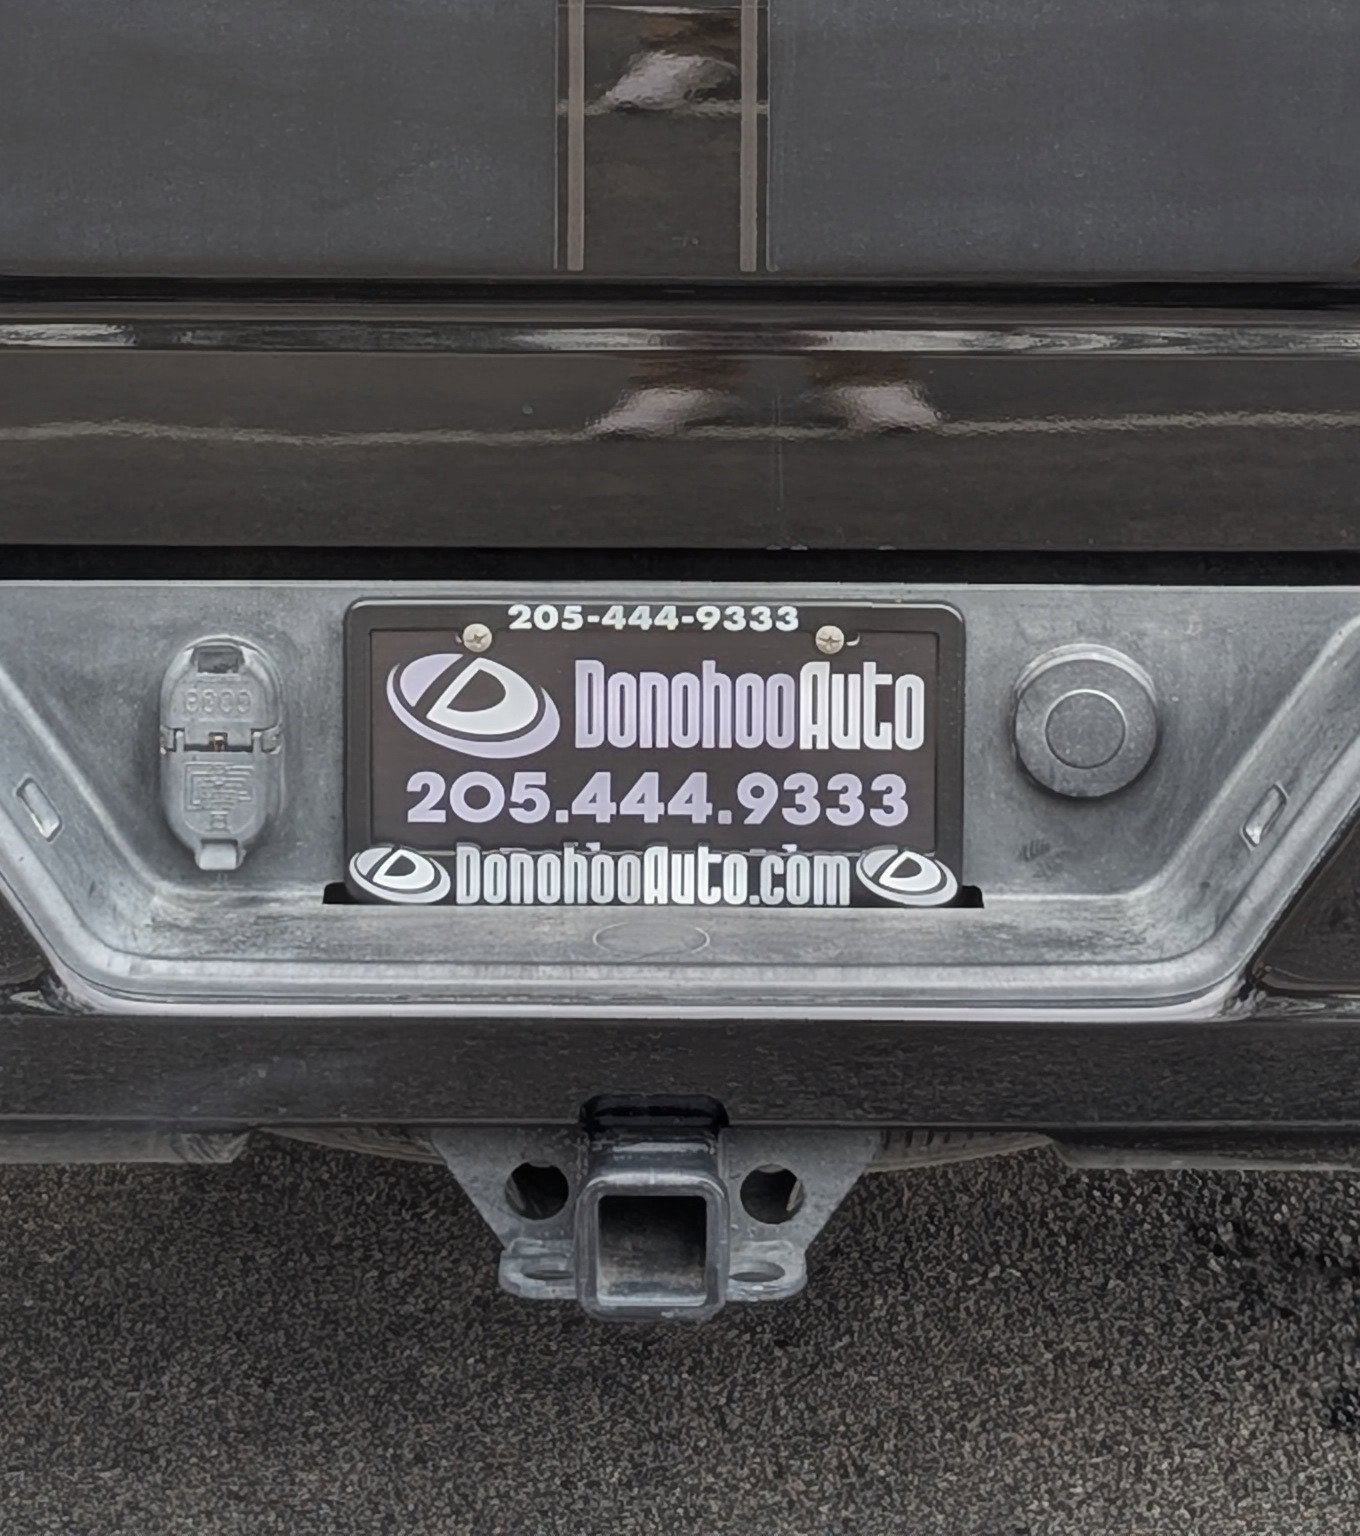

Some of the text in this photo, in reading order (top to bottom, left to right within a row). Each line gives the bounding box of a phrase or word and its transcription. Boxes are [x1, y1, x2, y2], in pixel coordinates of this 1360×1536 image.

[508, 604, 800, 632] 205-444-9333
[574, 660, 925, 750] DonohooAuto
[406, 771, 910, 826] 205.444.9333
[455, 844, 851, 907] DonohooAuto.com
